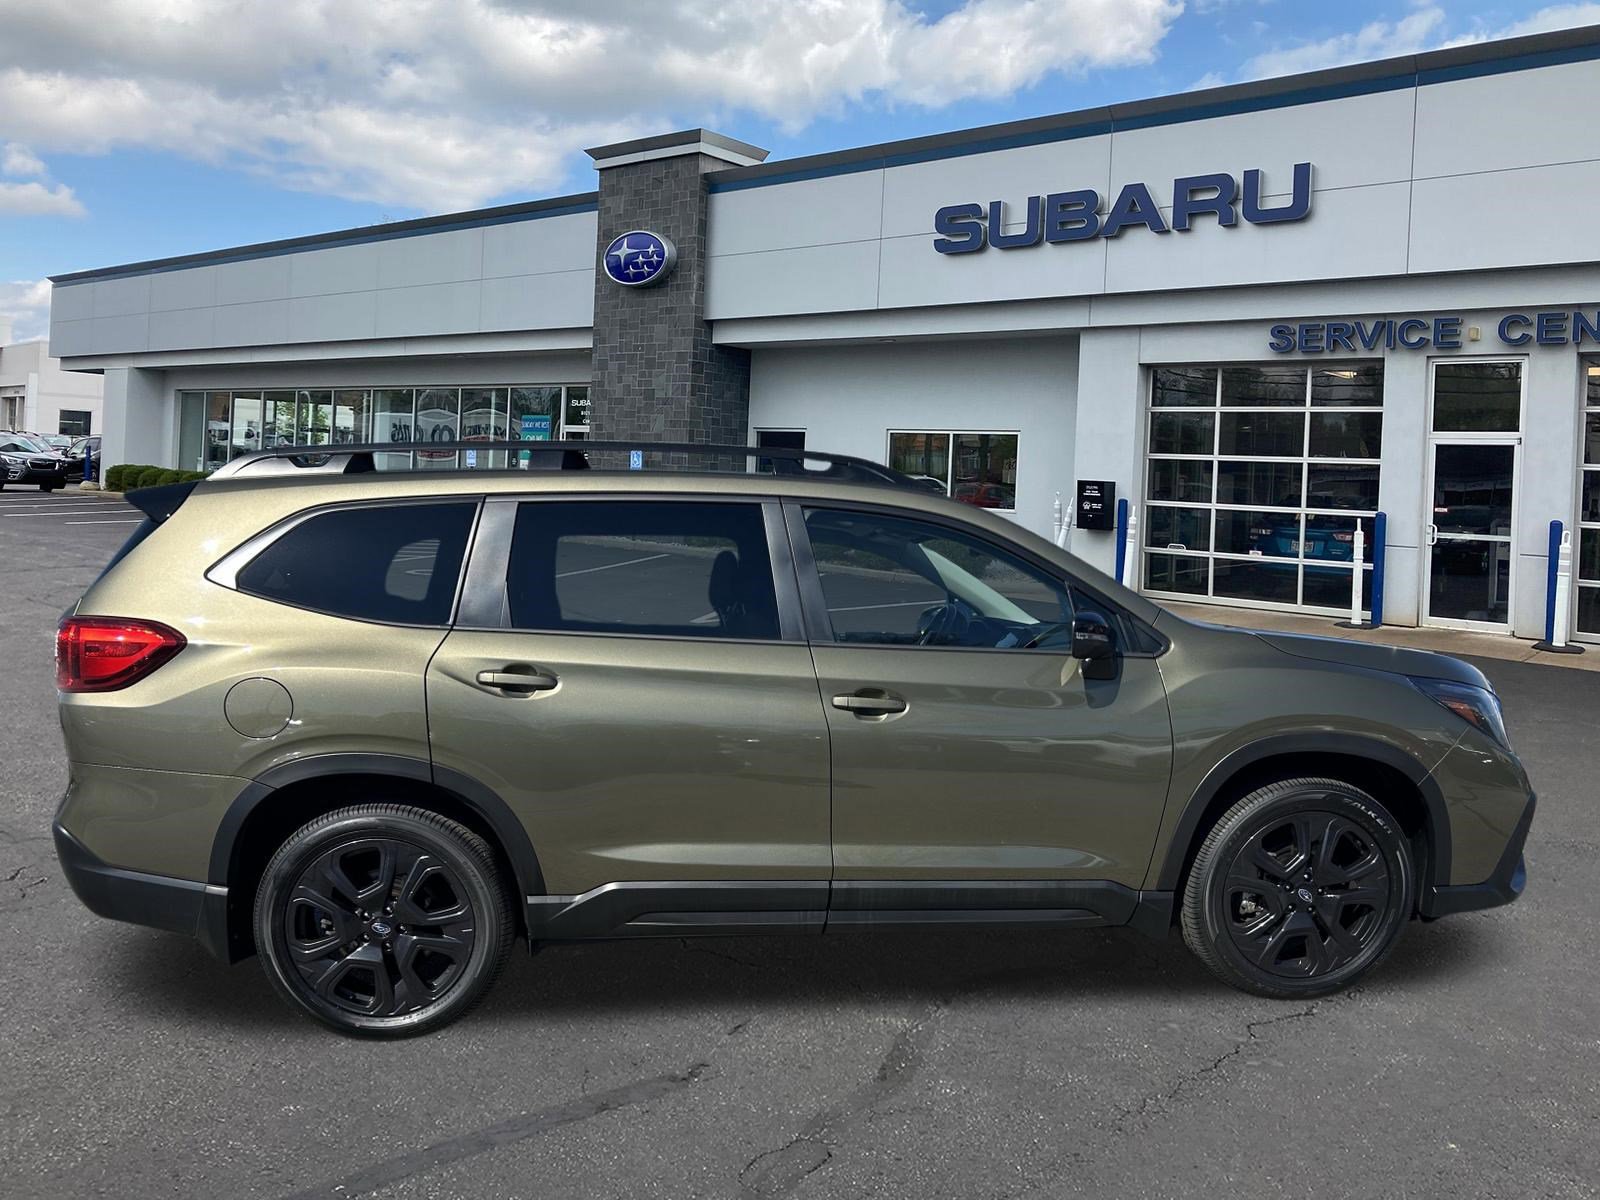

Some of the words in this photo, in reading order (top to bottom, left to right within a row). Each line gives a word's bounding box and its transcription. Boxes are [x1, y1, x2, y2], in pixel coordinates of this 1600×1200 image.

[933, 162, 1314, 254] SUBARU
[1269, 317, 1464, 353] SERVICE
[1497, 310, 1600, 346] CEN
